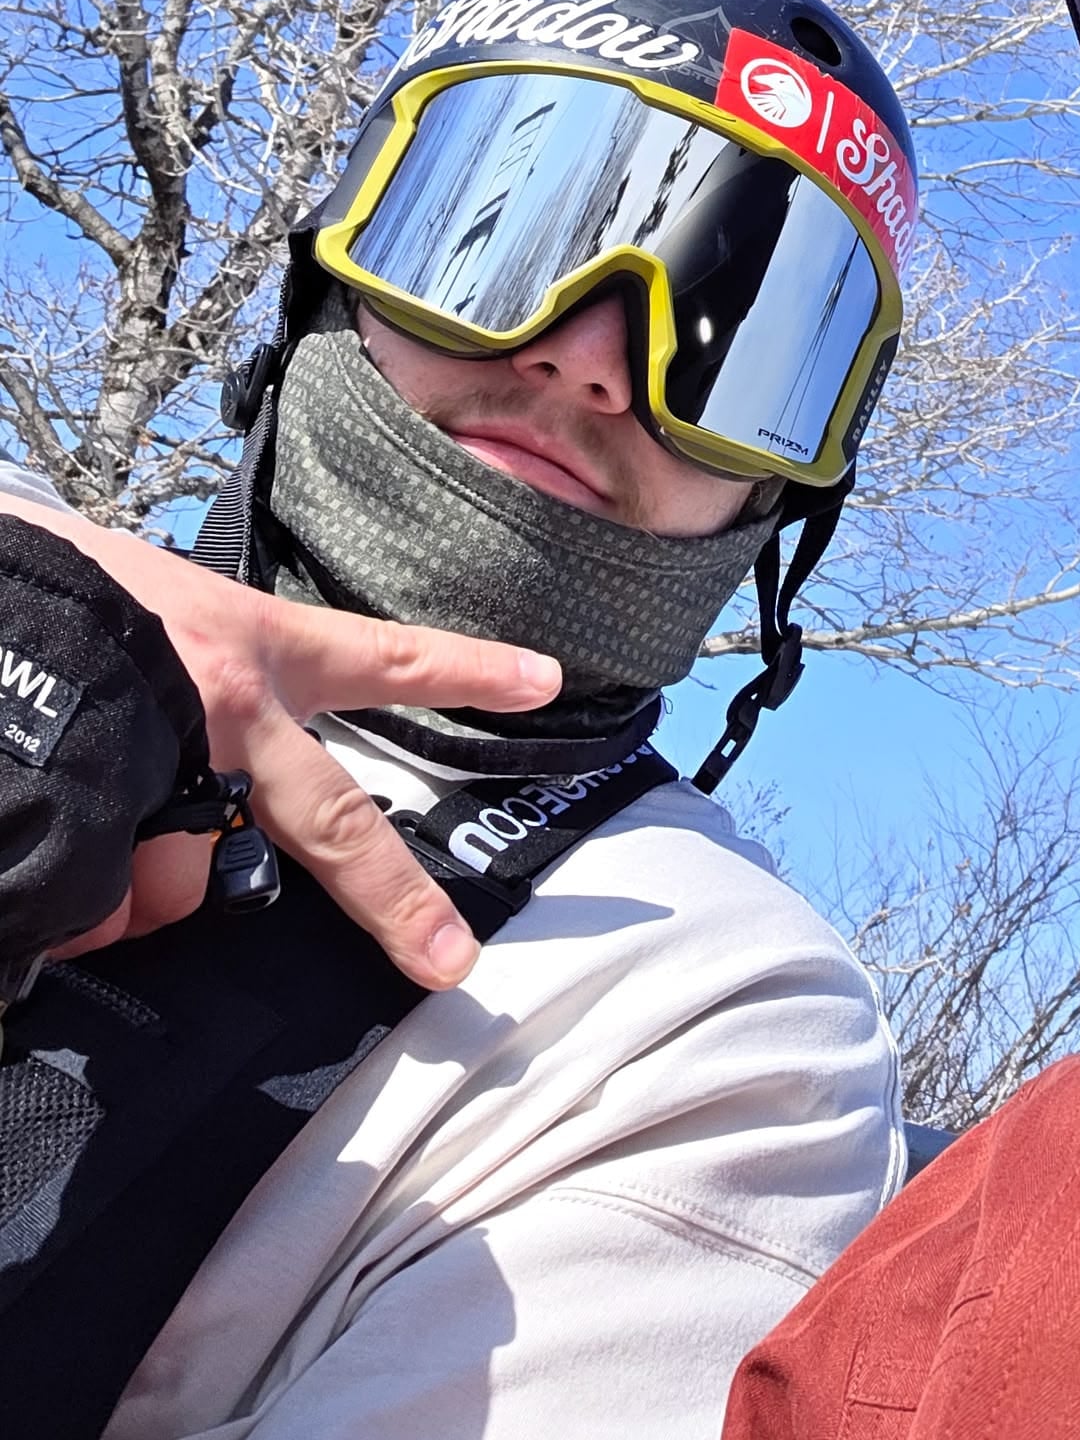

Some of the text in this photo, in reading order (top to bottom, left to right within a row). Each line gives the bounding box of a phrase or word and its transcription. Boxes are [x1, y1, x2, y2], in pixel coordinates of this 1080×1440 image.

[852, 359, 887, 442] OAKLEY
[757, 428, 809, 456] PRIZM
[0, 645, 58, 718] WL
[4, 723, 41, 753] 2012
